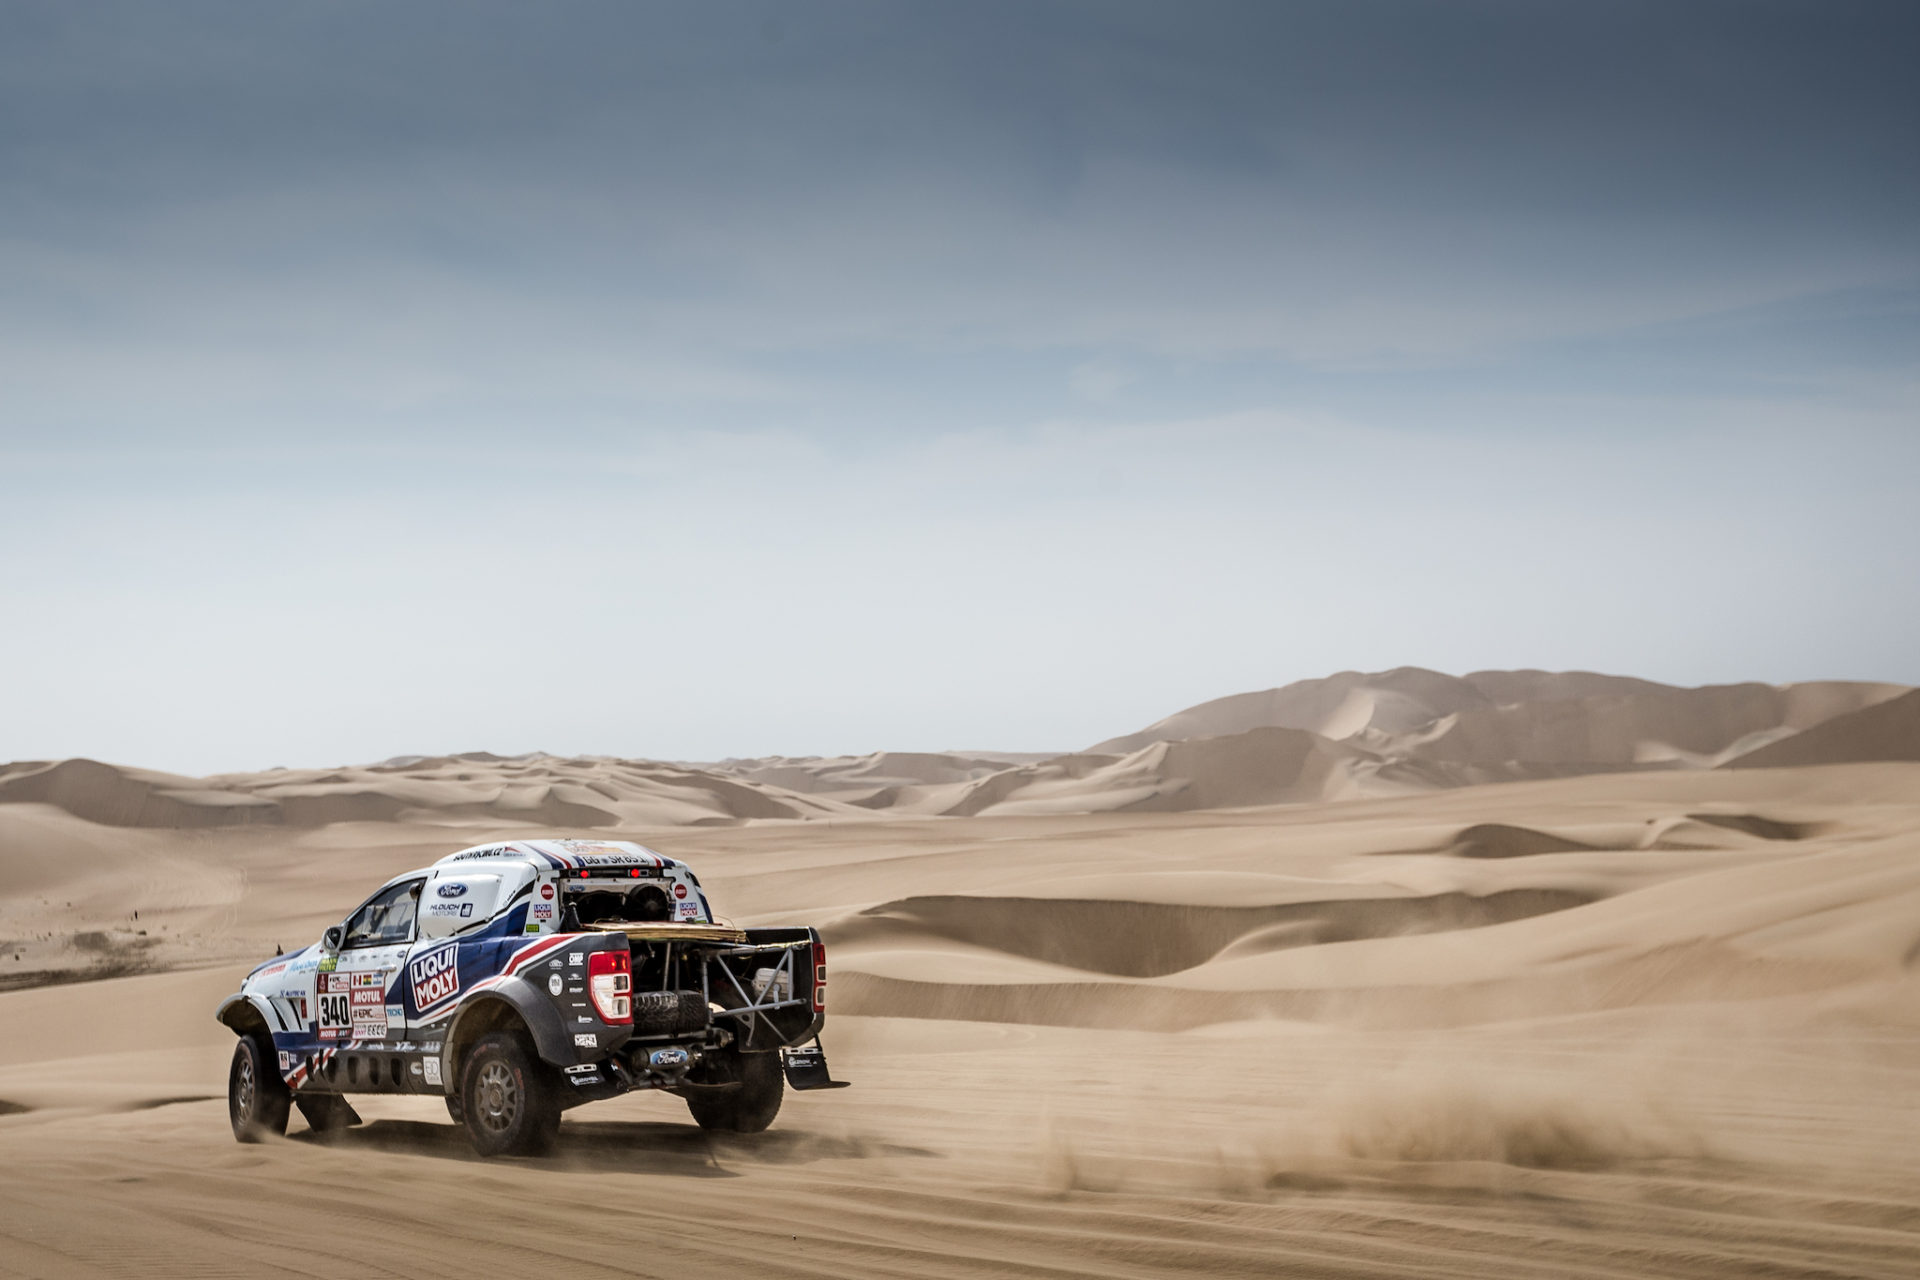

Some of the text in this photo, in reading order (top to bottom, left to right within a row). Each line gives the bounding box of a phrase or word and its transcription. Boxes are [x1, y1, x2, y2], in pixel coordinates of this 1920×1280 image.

[413, 947, 454, 984] LIQUI
[353, 990, 381, 1003] MOTUL
[416, 968, 455, 1006] MOLY
[320, 995, 350, 1027] 340
[320, 1030, 337, 1038] MOTUL
[657, 1050, 682, 1064] Ford
